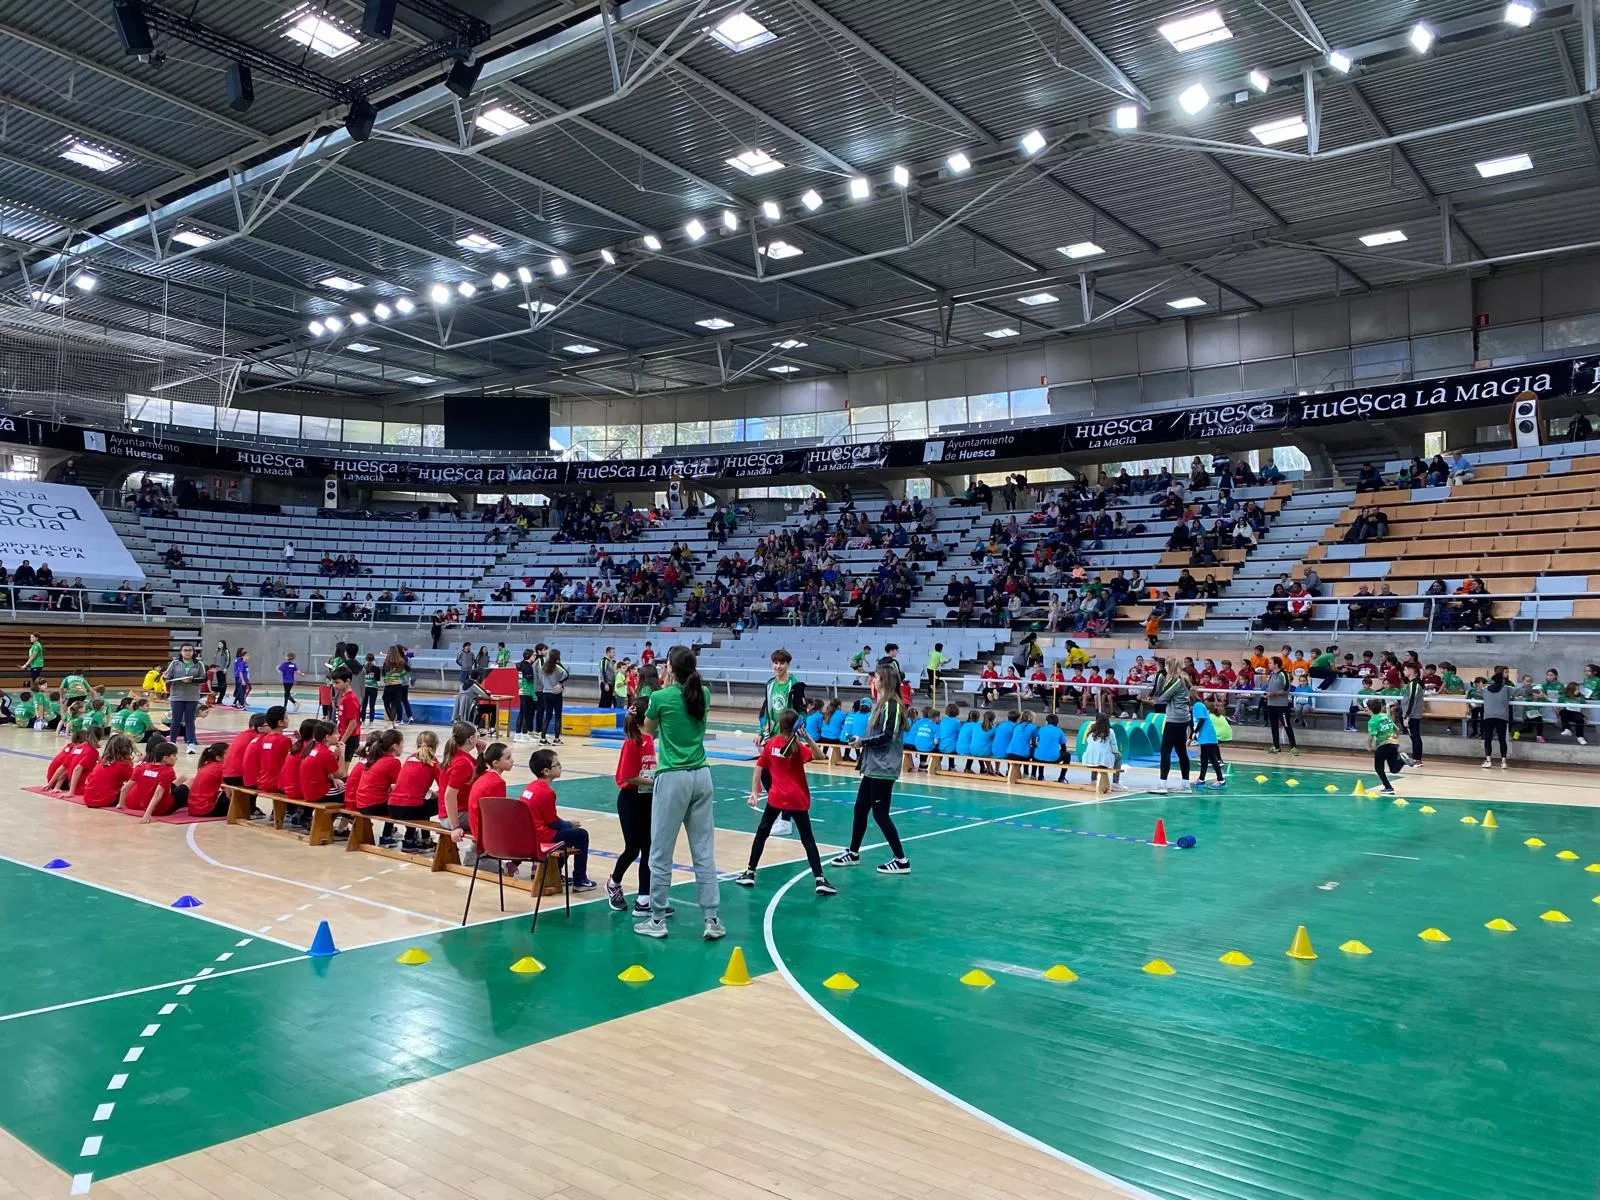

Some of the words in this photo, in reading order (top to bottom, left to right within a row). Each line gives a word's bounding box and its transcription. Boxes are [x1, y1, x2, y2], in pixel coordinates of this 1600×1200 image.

[110, 434, 180, 453] Ayuntamiento
[947, 435, 1015, 451] Ayuntamiento
[110, 446, 123, 455] de
[126, 446, 163, 461] Huesca
[944, 452, 957, 461] de
[959, 449, 996, 460] Huesca
